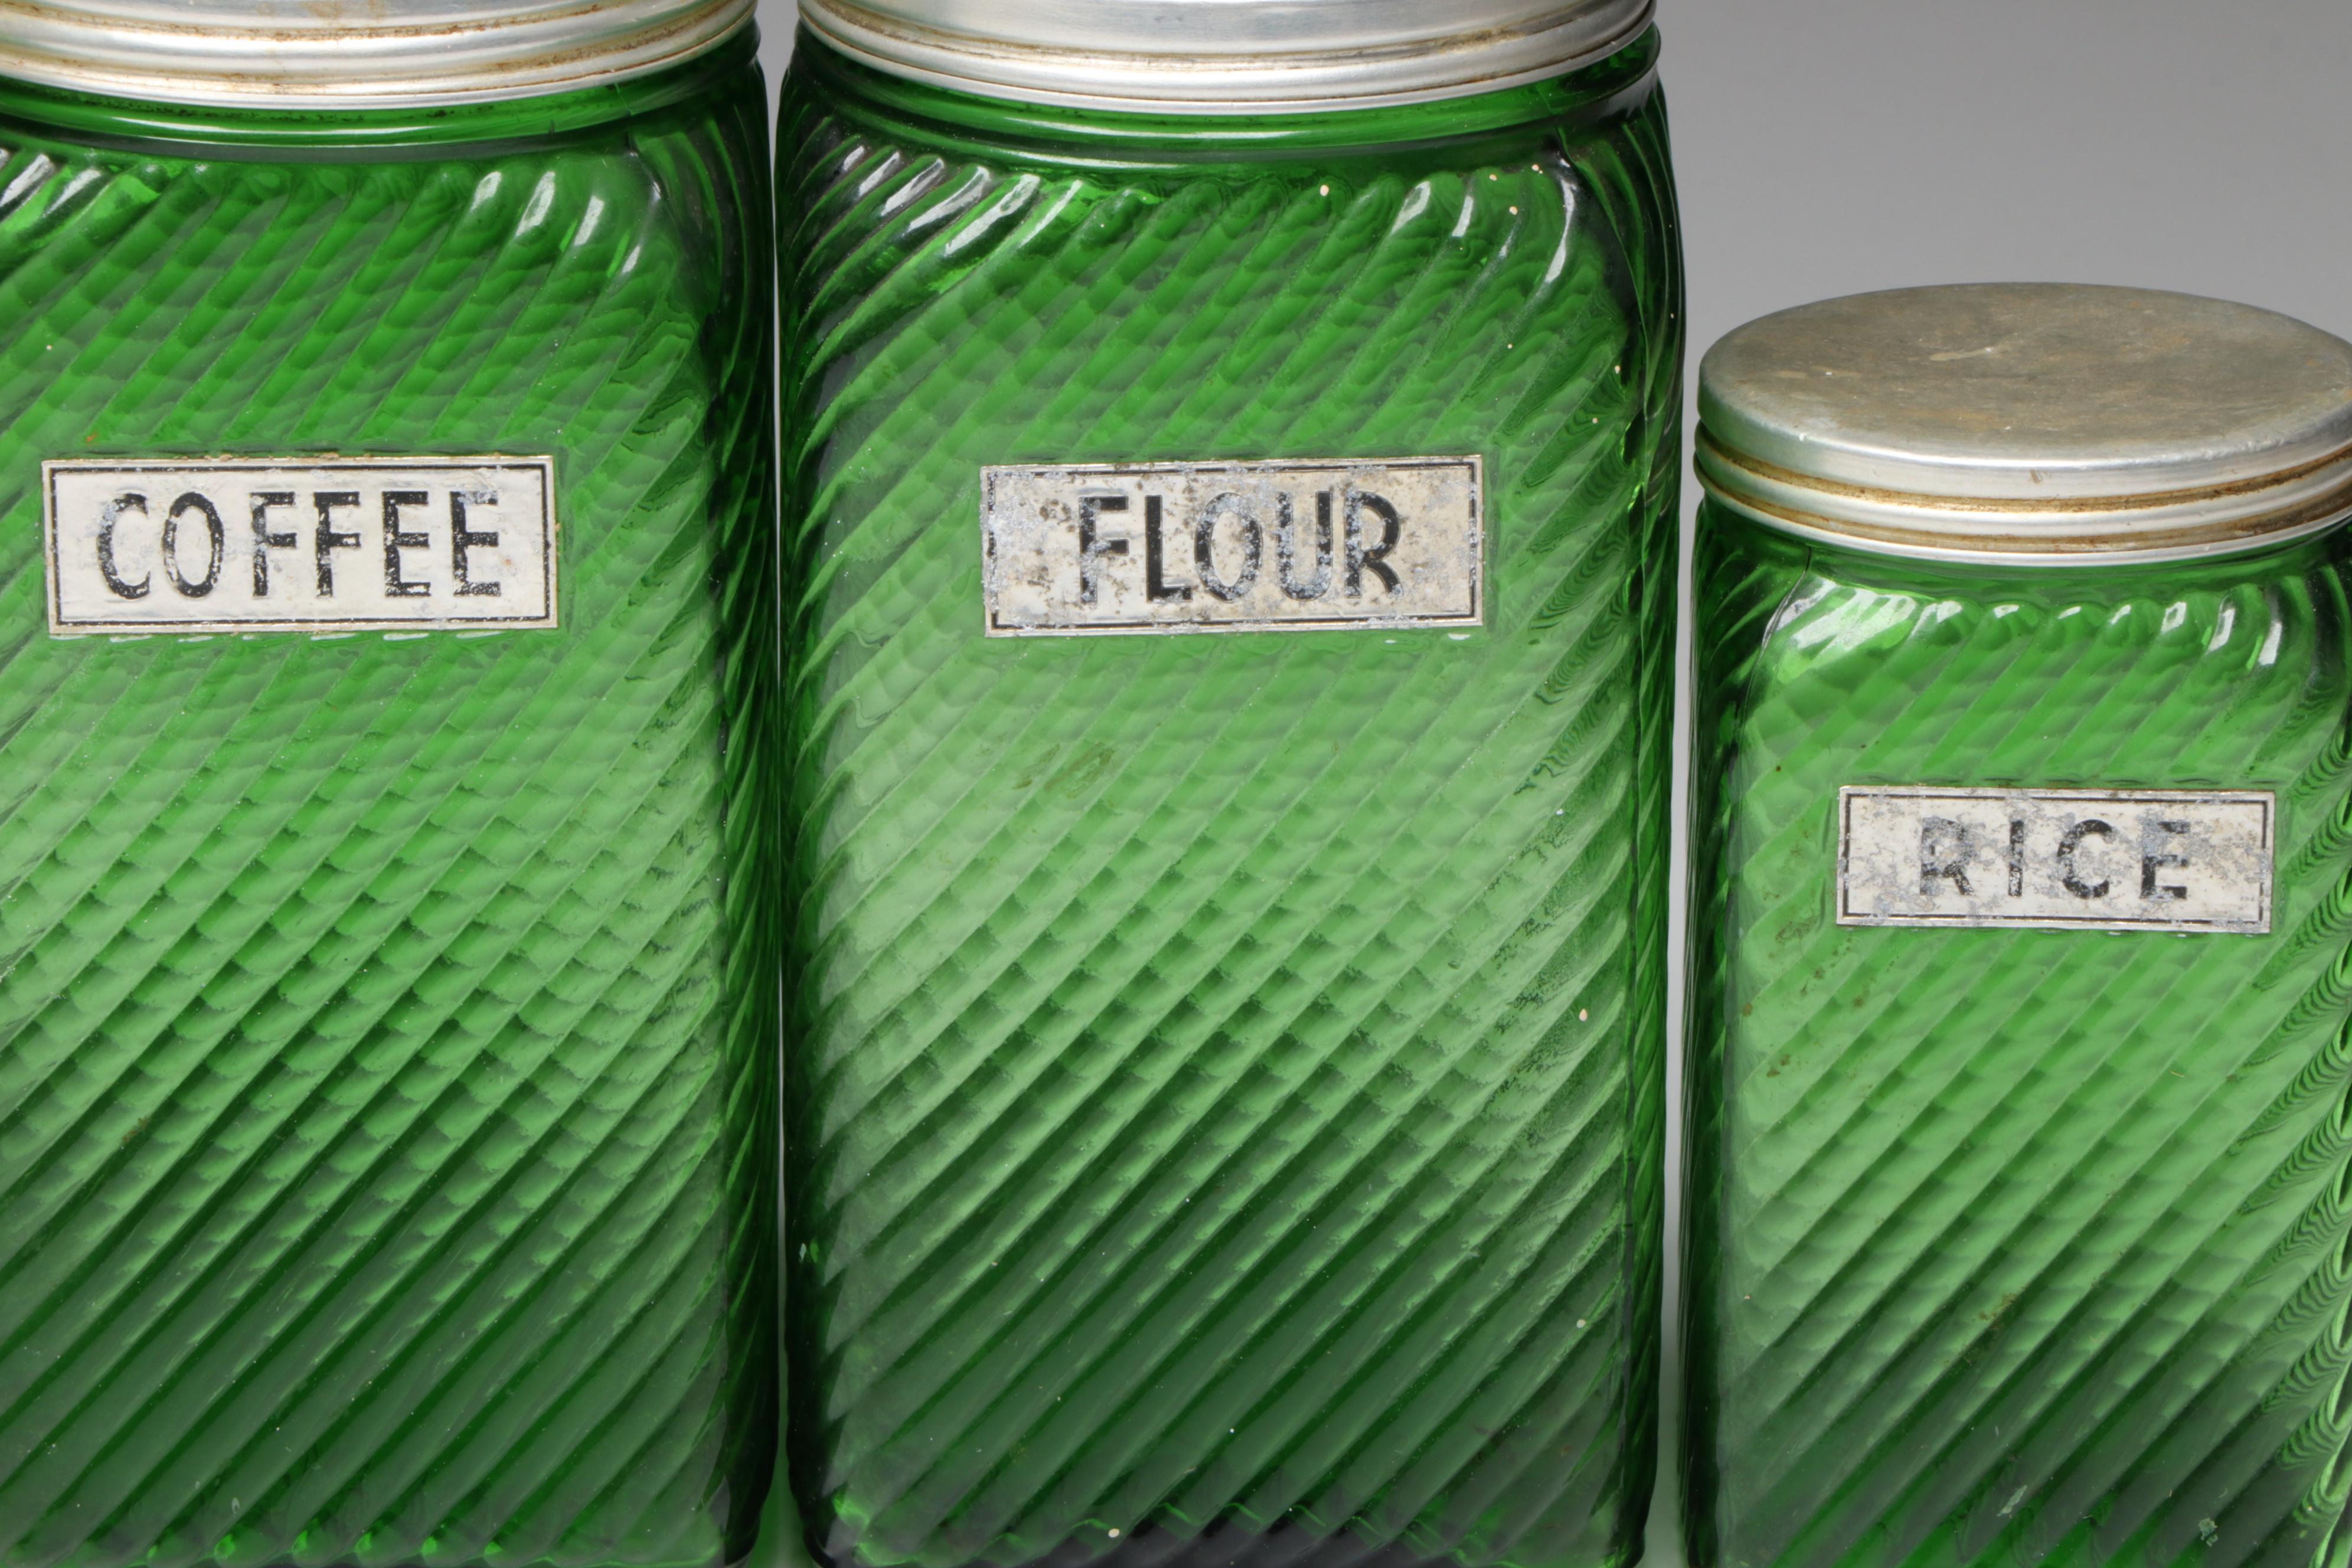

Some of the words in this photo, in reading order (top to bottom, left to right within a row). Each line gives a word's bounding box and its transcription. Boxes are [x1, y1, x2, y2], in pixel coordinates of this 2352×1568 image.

[96, 490, 502, 600] COFFEE
[1077, 489, 1404, 605] FLOUR
[1919, 817, 2191, 900] RICE
